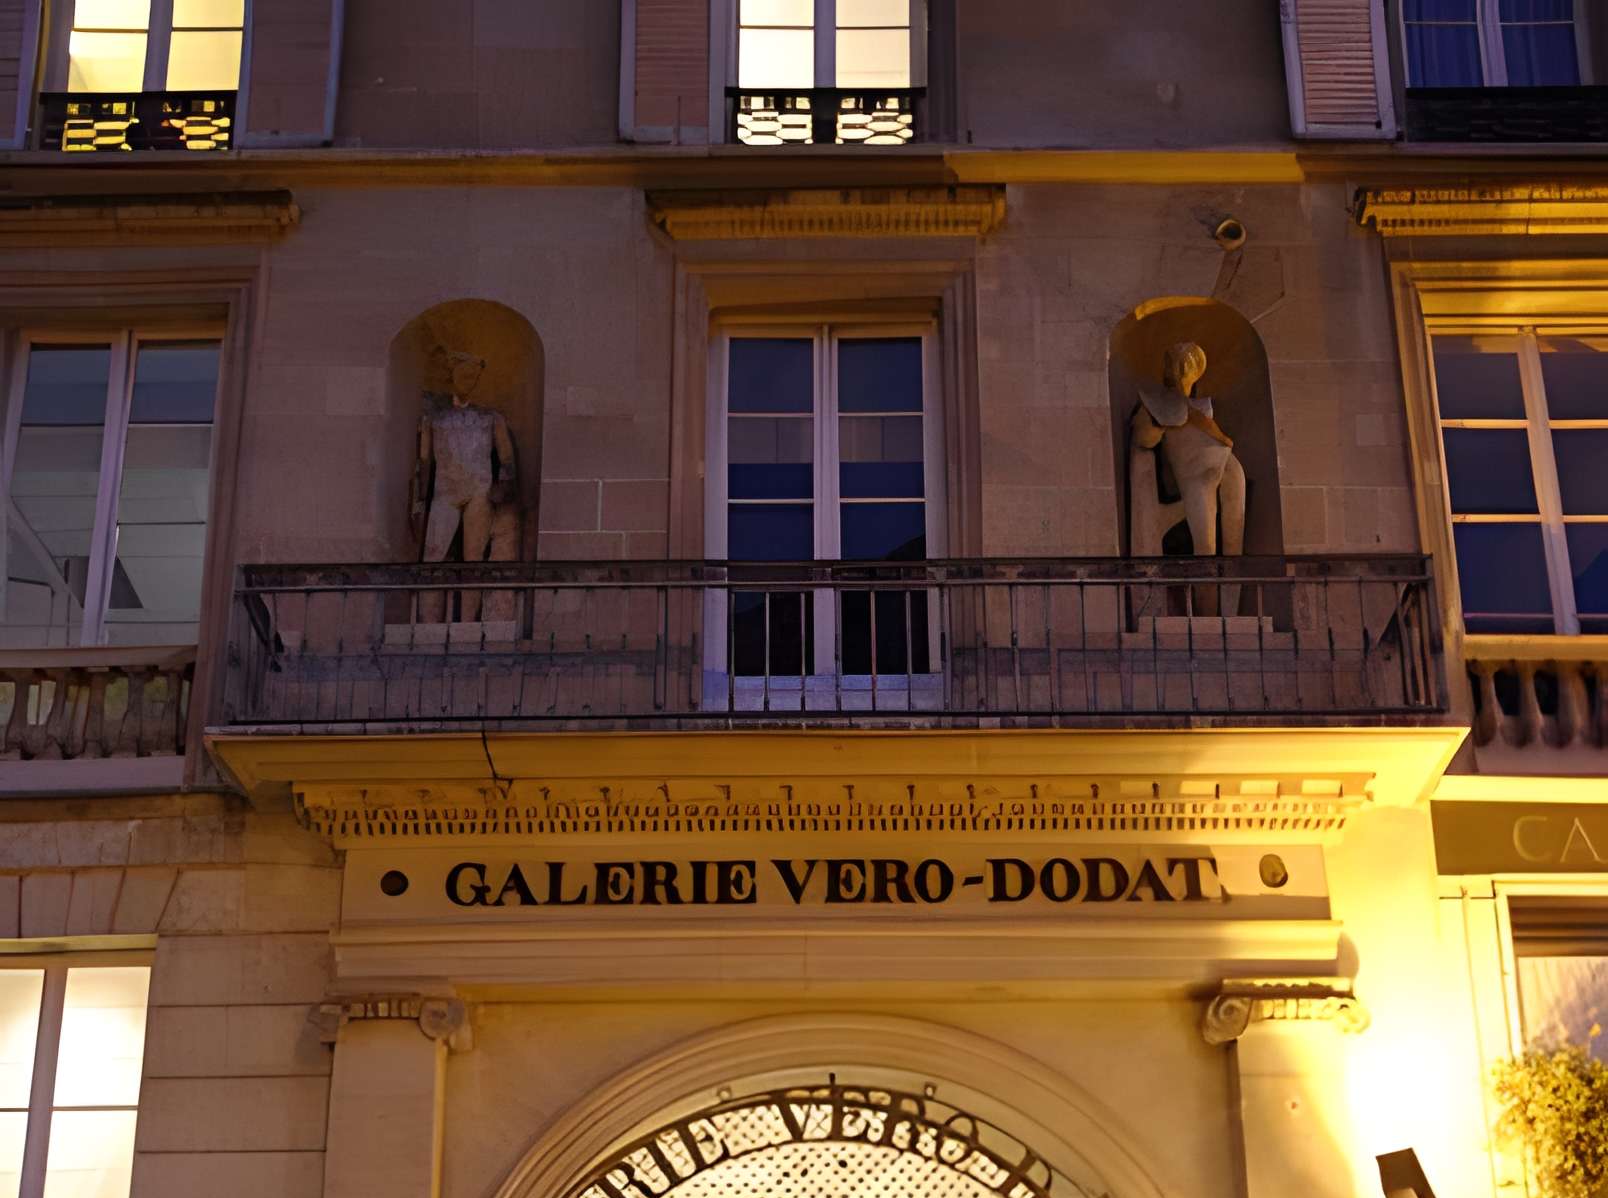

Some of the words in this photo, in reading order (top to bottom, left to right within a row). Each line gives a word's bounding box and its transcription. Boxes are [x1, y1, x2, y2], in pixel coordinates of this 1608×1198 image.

[1512, 814, 1608, 865] CA
[444, 861, 757, 907] GALERIE
[770, 857, 1219, 904] VERO-DODAT
